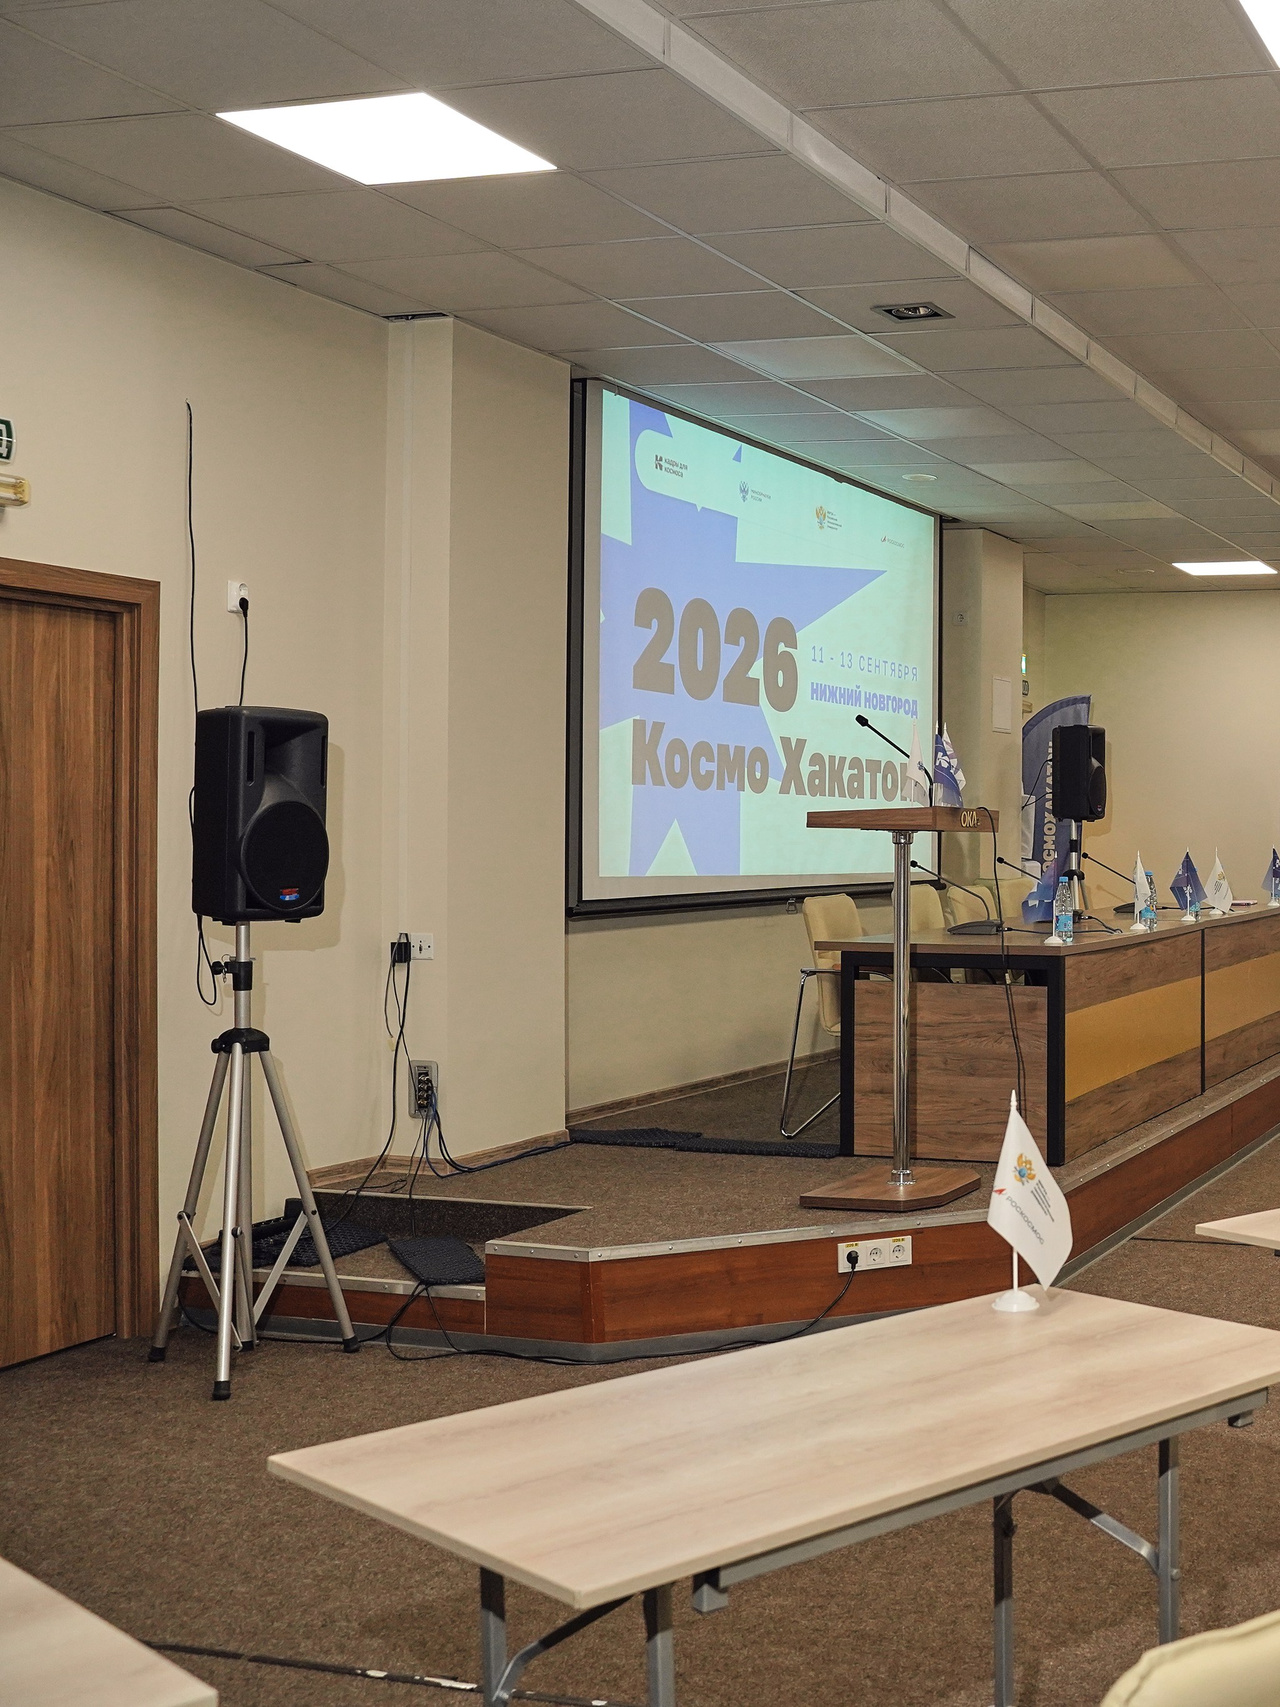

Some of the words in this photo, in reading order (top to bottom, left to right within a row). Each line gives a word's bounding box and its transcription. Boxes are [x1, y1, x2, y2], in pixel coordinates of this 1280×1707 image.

[632, 587, 798, 712] 2026
[811, 645, 824, 663] 11
[840, 651, 853, 669] 13
[859, 655, 918, 682] СЕНТЯБРЯ
[810, 682, 862, 707] НИЖНИЙ
[864, 691, 918, 719] НОВГОРОД
[632, 718, 770, 794] Космо
[1006, 1196, 1045, 1245] РОСКОСМОС
